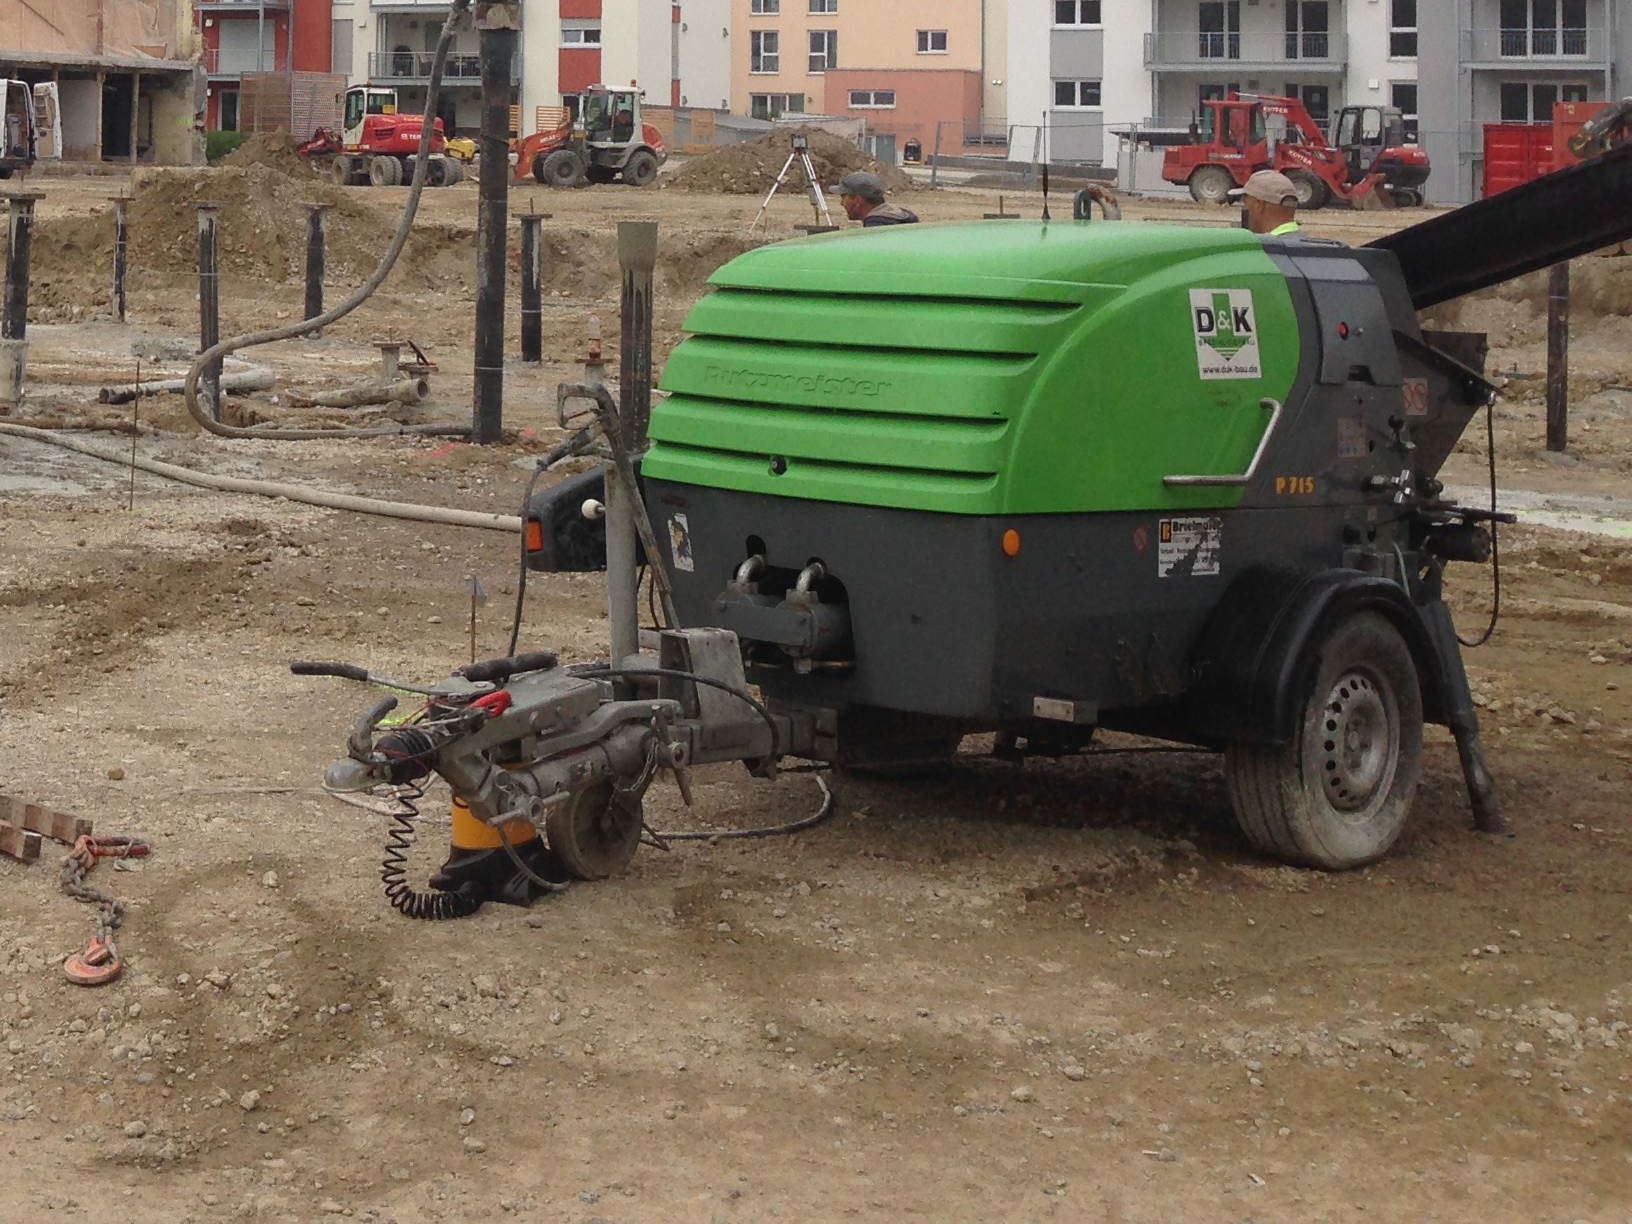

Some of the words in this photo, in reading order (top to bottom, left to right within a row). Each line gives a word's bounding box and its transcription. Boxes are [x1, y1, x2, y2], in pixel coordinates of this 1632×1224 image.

[1194, 307, 1253, 332] D&K
[1202, 364, 1258, 374] www.duk-bau.de
[1289, 478, 1315, 494] 715
